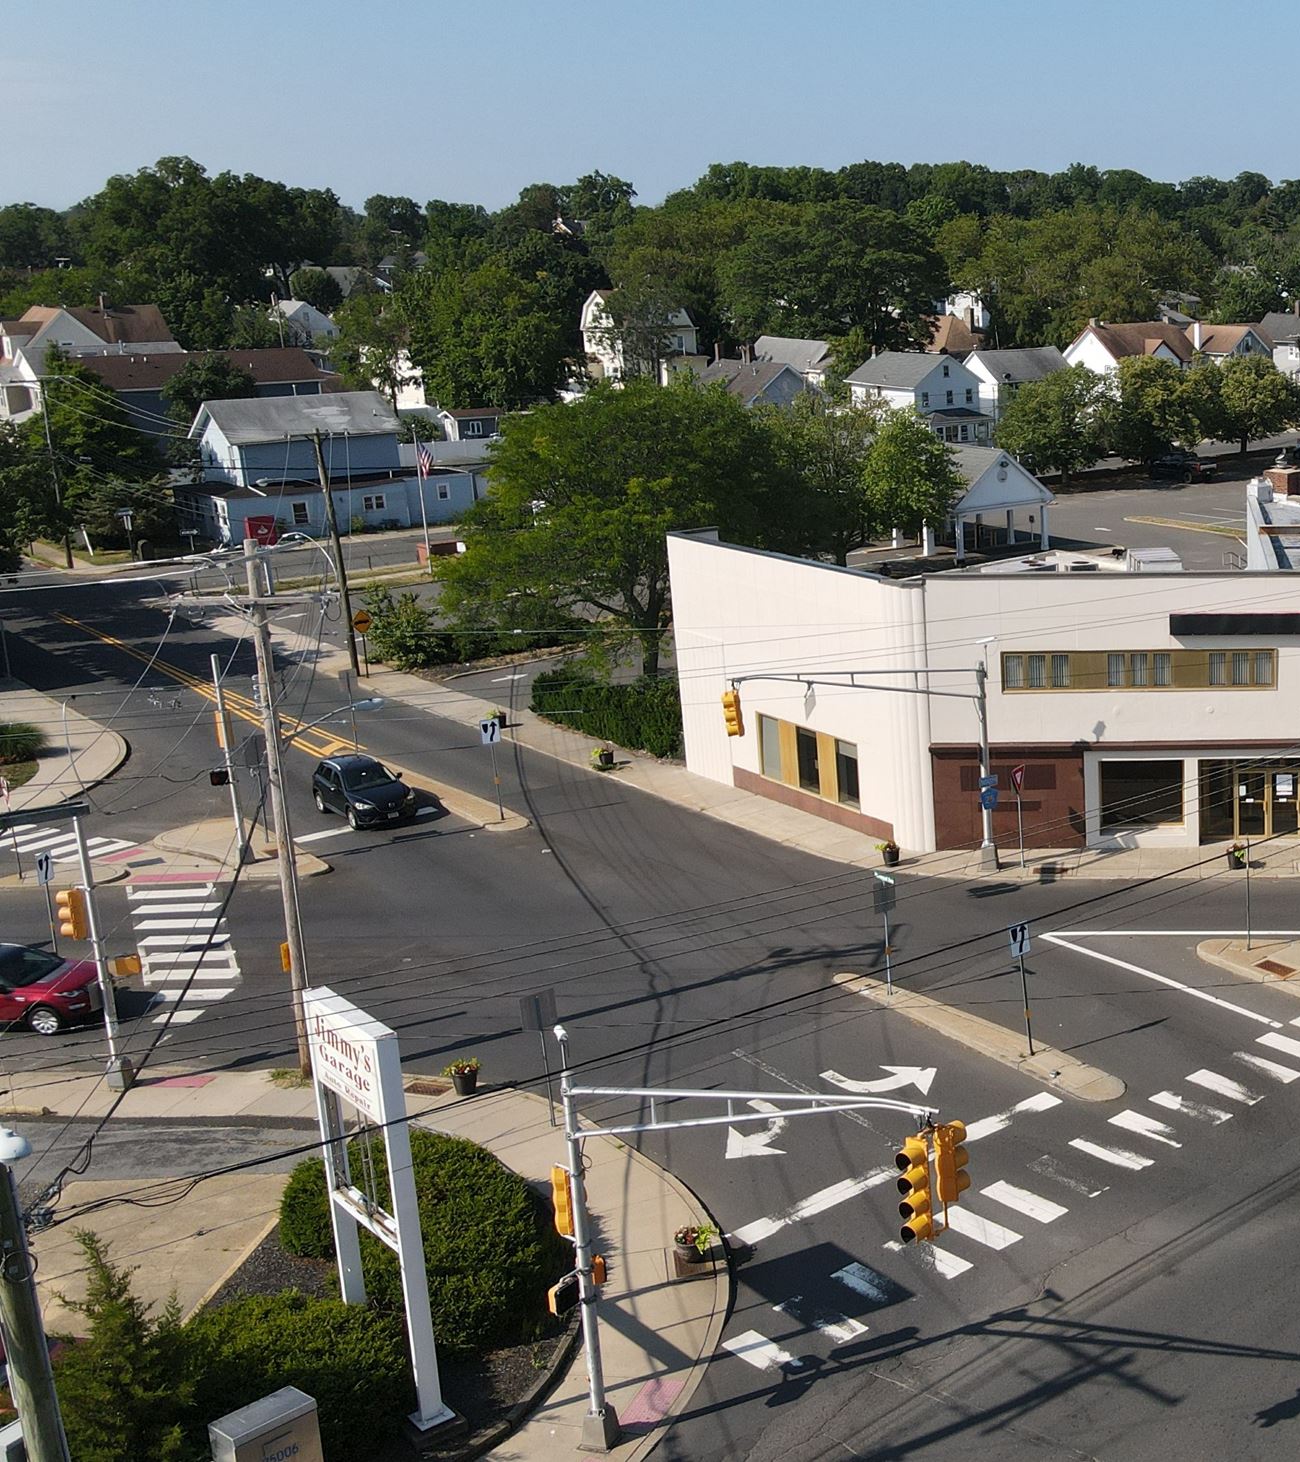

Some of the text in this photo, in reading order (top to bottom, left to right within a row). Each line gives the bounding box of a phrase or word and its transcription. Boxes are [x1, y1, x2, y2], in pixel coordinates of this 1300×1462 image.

[315, 1014, 371, 1073] Jimmy's
[319, 1045, 371, 1091] Garage
[324, 1071, 371, 1110] Auto Repair
